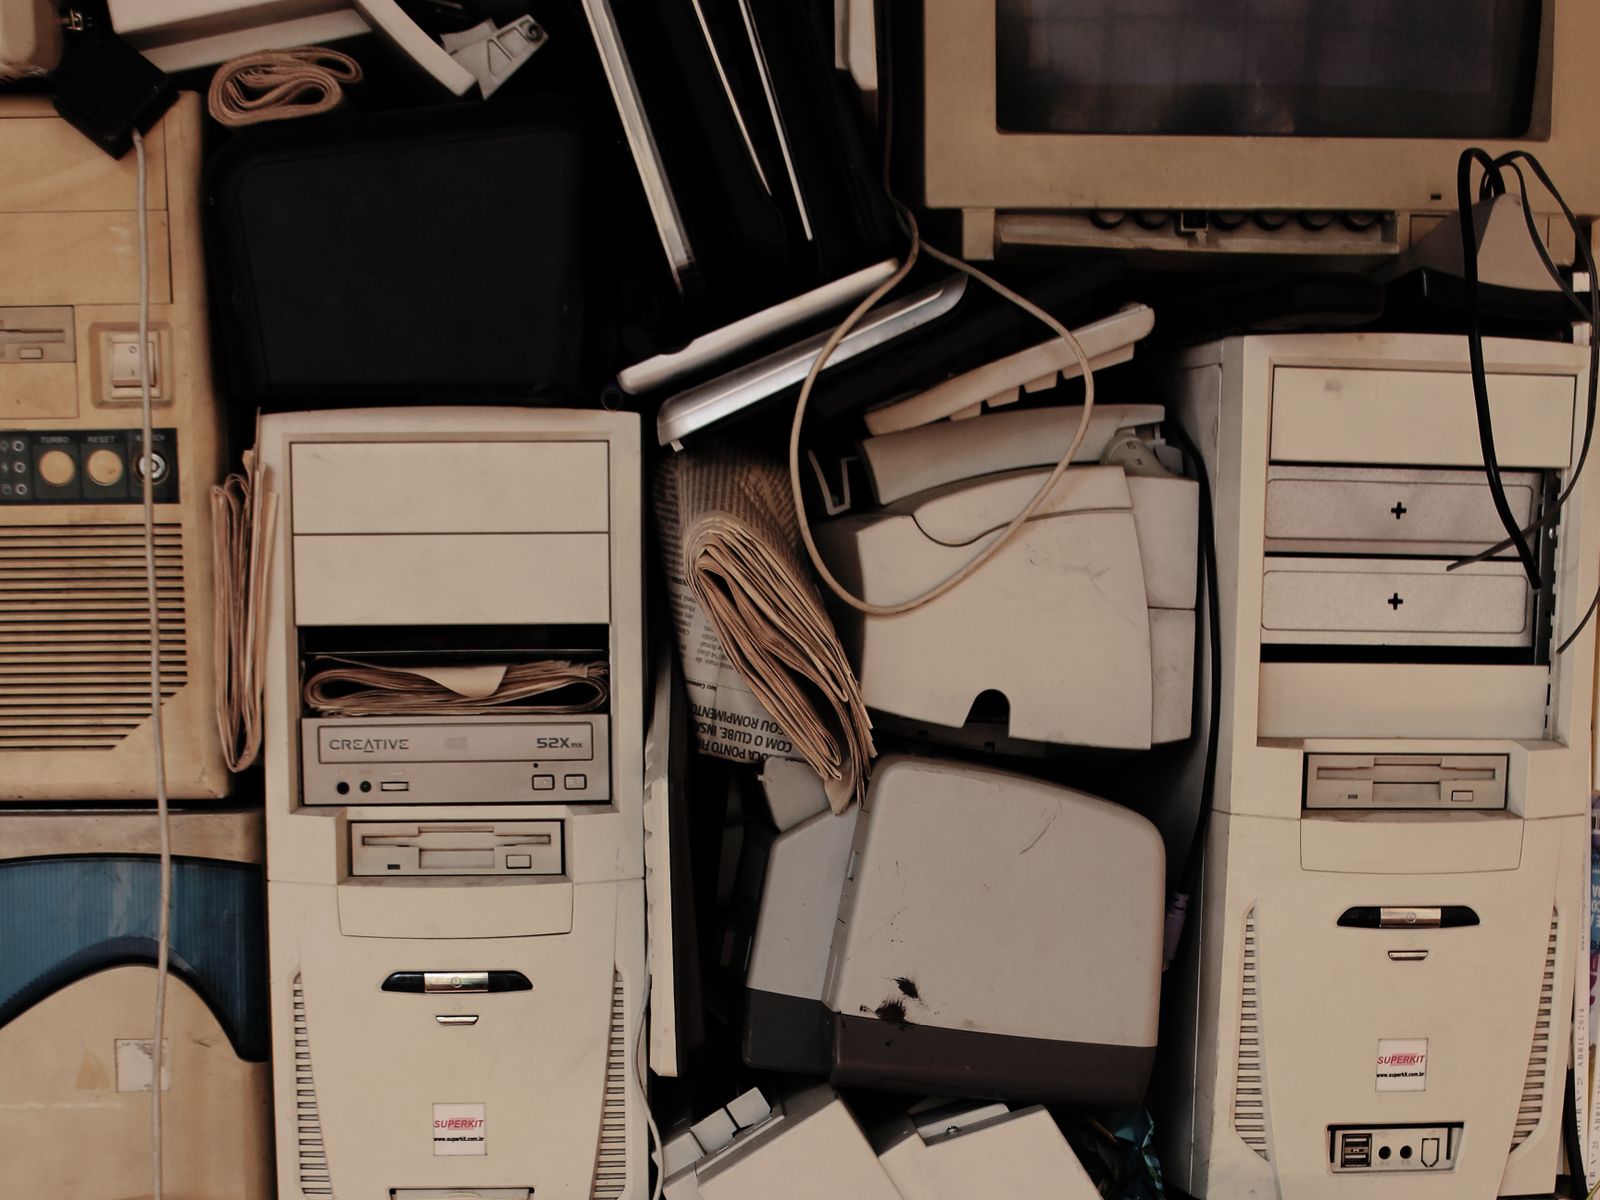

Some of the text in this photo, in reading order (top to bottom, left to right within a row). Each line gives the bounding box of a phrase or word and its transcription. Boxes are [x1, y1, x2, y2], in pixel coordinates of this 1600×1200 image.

[87, 435, 115, 443] RESET
[691, 704, 759, 729] ROMPIMENTO
[329, 738, 409, 753] CREATIVE
[536, 737, 570, 749] 52X
[754, 735, 764, 747] O
[765, 737, 793, 753] COM
[711, 741, 746, 760] PONTO
[1577, 1007, 1585, 1032] 2014
[1377, 1055, 1425, 1065] SUPERKIT
[1576, 1035, 1584, 1069] ABRIL
[433, 1119, 485, 1128] SUPERKIT
